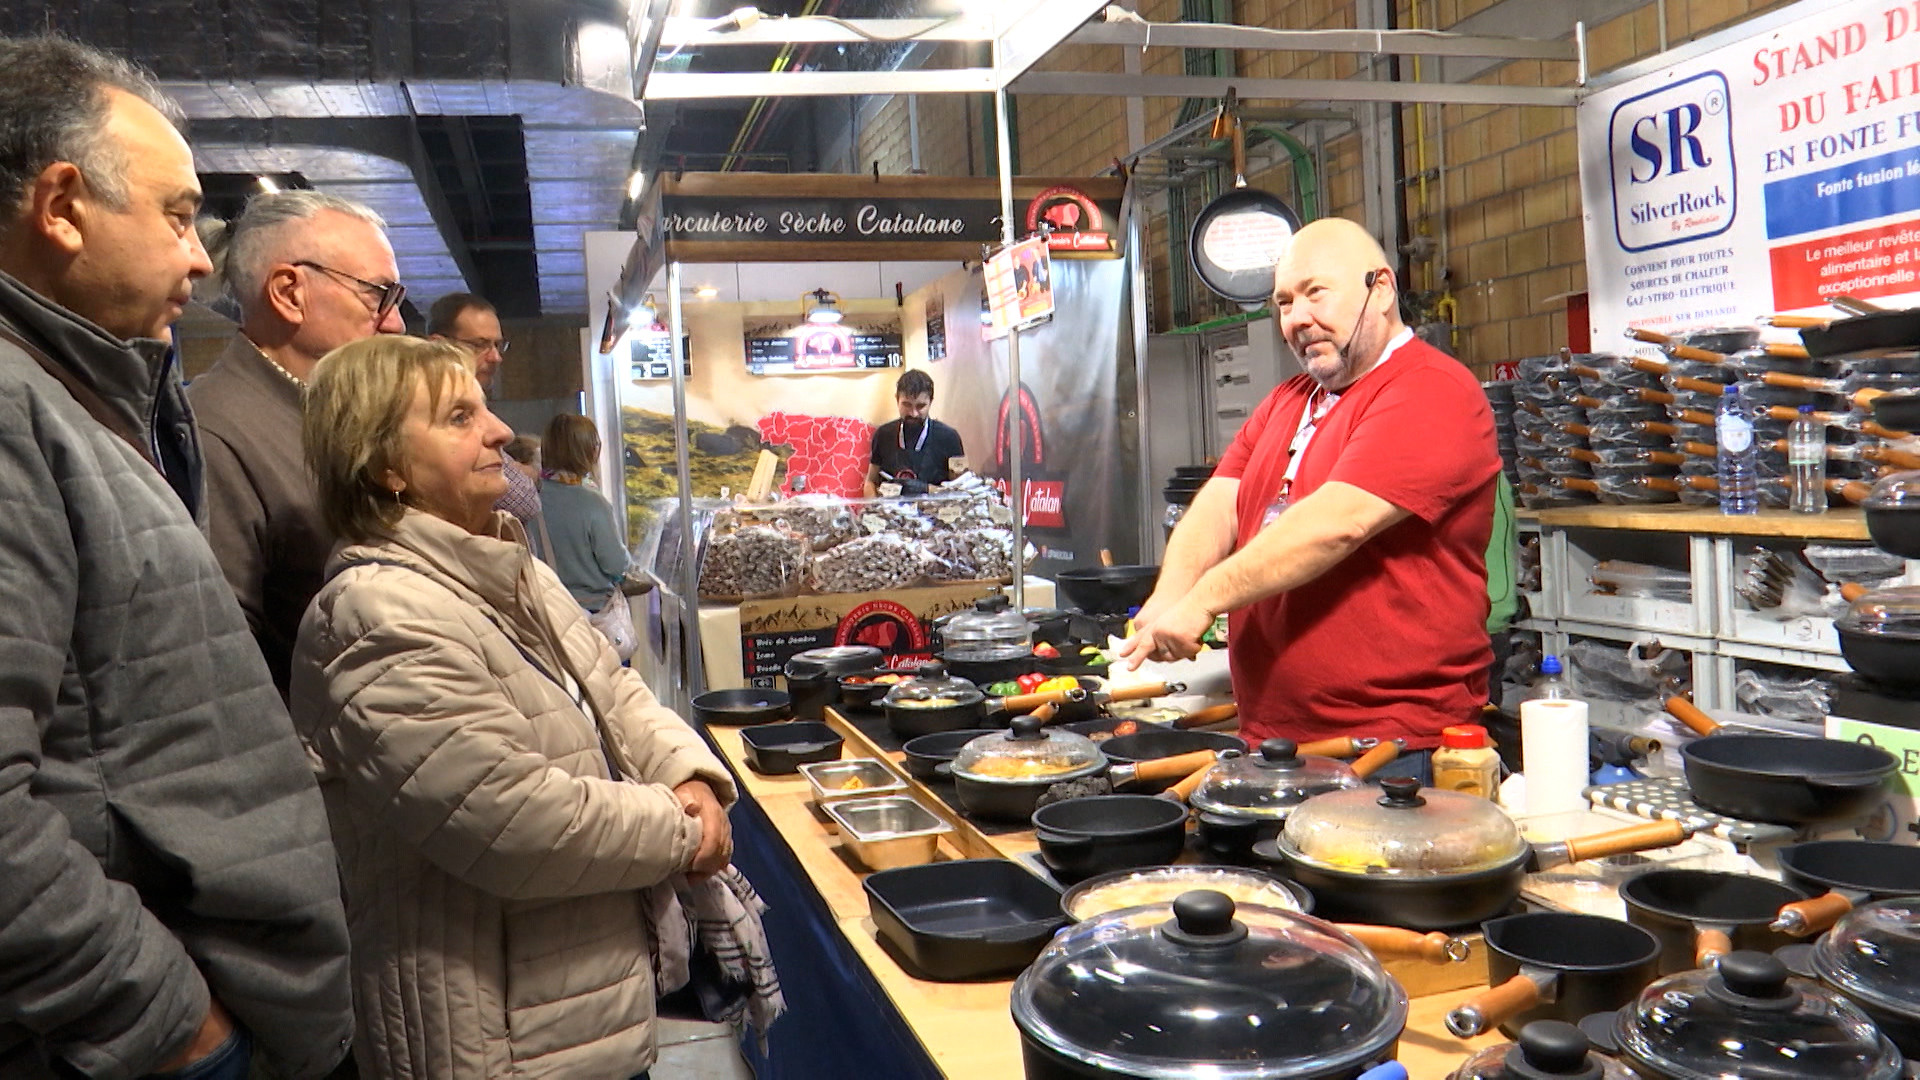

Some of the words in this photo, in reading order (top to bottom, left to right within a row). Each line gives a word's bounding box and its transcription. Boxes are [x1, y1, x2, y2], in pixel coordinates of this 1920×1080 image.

[1753, 22, 1866, 87] STAND
[1778, 92, 1826, 133] DU
[1630, 102, 1712, 186] SR
[1765, 145, 1795, 173] EN
[1805, 120, 1887, 163] FONTE
[1817, 176, 1854, 198] Fonte
[1856, 164, 1904, 188] fusion
[779, 210, 846, 235] Sèche
[856, 204, 965, 236] Catalane
[1630, 185, 1726, 226] SilverRock
[1670, 254, 1695, 269] POUR
[1698, 247, 1735, 262] TOUTES
[1806, 248, 1822, 262] Le
[1824, 238, 1876, 258] meilleur
[1820, 253, 1892, 277] alimentaire
[1894, 249, 1910, 265] et
[1630, 275, 1669, 292] SOURCES
[1671, 273, 1682, 284] DE
[1685, 264, 1729, 281] CHALEUR
[1818, 268, 1915, 296] exceptionnelle
[1675, 311, 1691, 321] SUR
[1694, 305, 1737, 320] DEMANDE
[1021, 477, 1061, 528] Catalan
